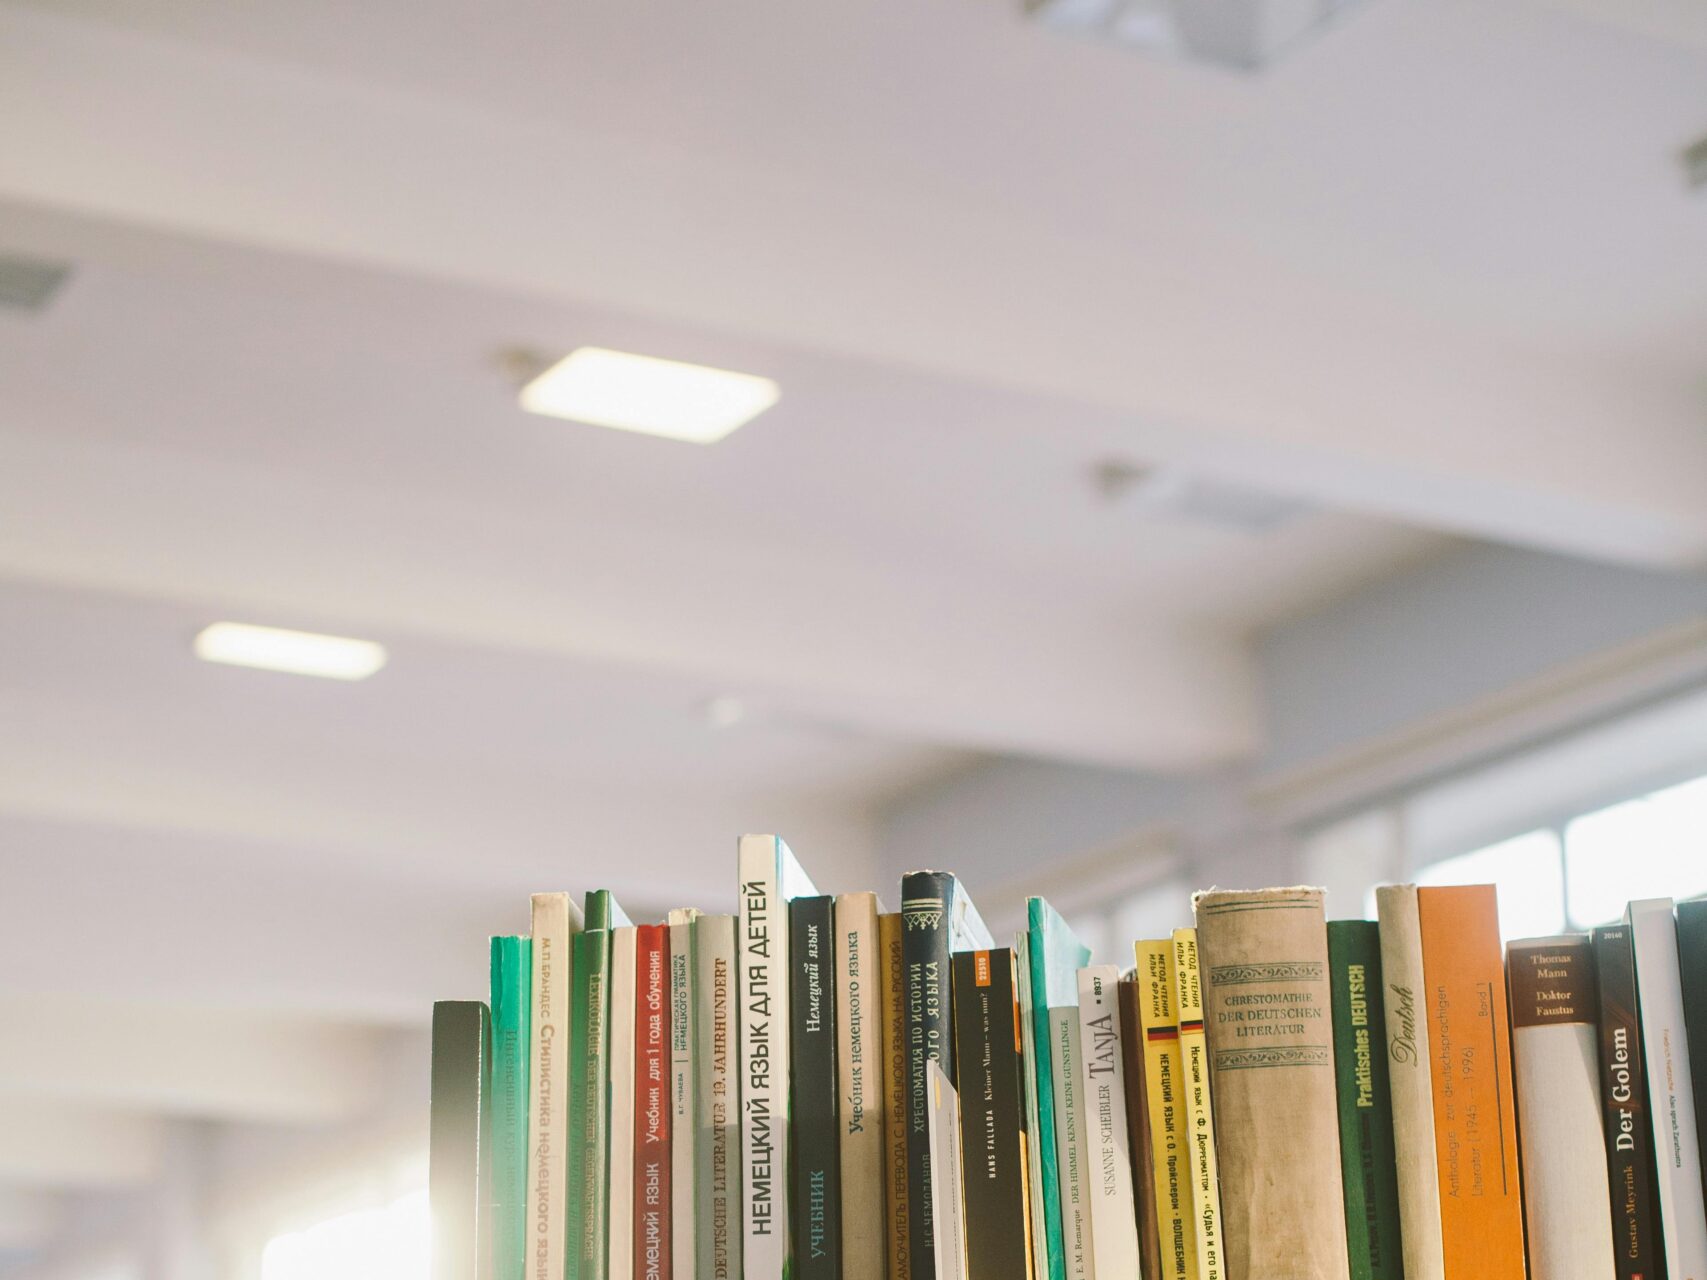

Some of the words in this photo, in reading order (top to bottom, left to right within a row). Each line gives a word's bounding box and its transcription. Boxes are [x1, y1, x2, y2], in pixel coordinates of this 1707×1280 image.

[743, 881, 769, 957] ДЕТЕЙ
[807, 924, 818, 958] язык
[847, 931, 859, 976] языка
[889, 940, 902, 992] РУССКИЙ
[1176, 941, 1186, 965] ИЛЬИ
[1187, 940, 1196, 969] МЕТОД
[1530, 954, 1571, 964] Thomas
[1537, 969, 1567, 979] Mann
[646, 950, 661, 1009] обучения
[748, 965, 770, 1016] ДЛЯ
[804, 963, 820, 1031] Немецкий
[910, 963, 921, 1021] ИСТОРИИ
[1093, 976, 1101, 995] 8937
[1178, 971, 1189, 1008] ФРАНКА
[1190, 975, 1199, 1007] ЧТЕНИЯ
[1224, 993, 1313, 1006] CHRESTOMATHIE
[1348, 964, 1367, 1026] DEUTSCH
[1536, 990, 1571, 1001] Doktor
[713, 957, 726, 1072] JAHRHUNDERT
[849, 982, 861, 1063] немецкого
[891, 995, 901, 1011] НА
[1218, 1012, 1244, 1023] DER
[1247, 1007, 1322, 1021] DEUTSCHEN
[1390, 982, 1416, 1068] Deutsch
[1536, 1006, 1574, 1017] Faustus
[648, 1013, 661, 1044] года
[891, 1016, 902, 1051] ЯЗЫКА
[911, 1027, 921, 1043] ПО
[1060, 1018, 1071, 1077] GÜNSTLINGE
[1085, 1012, 1120, 1078] TANJA
[1236, 1024, 1305, 1037] LITERATUR
[1436, 984, 1453, 1098] deutschsprachigen
[648, 1057, 660, 1080] для
[749, 1023, 768, 1088] ЯЗЫК
[1353, 1029, 1372, 1106] Praktisches
[1609, 1027, 1630, 1102] Golem
[713, 1077, 725, 1095] 19.
[848, 1066, 863, 1133] Учебник
[892, 1054, 905, 1123] НЕМЕЦКОГО
[912, 1048, 924, 1132] ХРЕСТОМАТИЯ
[1064, 1080, 1073, 1107] KEINE
[645, 1087, 661, 1142] Учебник
[894, 1129, 903, 1138] С
[1066, 1110, 1075, 1141] KENNT
[1097, 1084, 1112, 1143] SCHEIBLER
[1445, 1103, 1454, 1120] zur
[1614, 1108, 1634, 1150] Der
[713, 1102, 726, 1191] LITERATUR
[747, 1098, 774, 1233] НЕМЕЦКИЙ
[1068, 1144, 1078, 1182] HIMMEL
[1446, 1131, 1460, 1197] Anthologie
[646, 1162, 660, 1205] язык
[893, 1141, 906, 1199] ПЕРЕВОДА
[1102, 1147, 1116, 1195] SUSANNE
[1623, 1165, 1637, 1213] Meyrink
[809, 1169, 825, 1257] УЧЕБНИК
[1070, 1184, 1079, 1203] DER
[713, 1197, 727, 1278] DEUTSCHE
[1074, 1209, 1083, 1249] Remarque
[1627, 1217, 1638, 1258] Gustav
